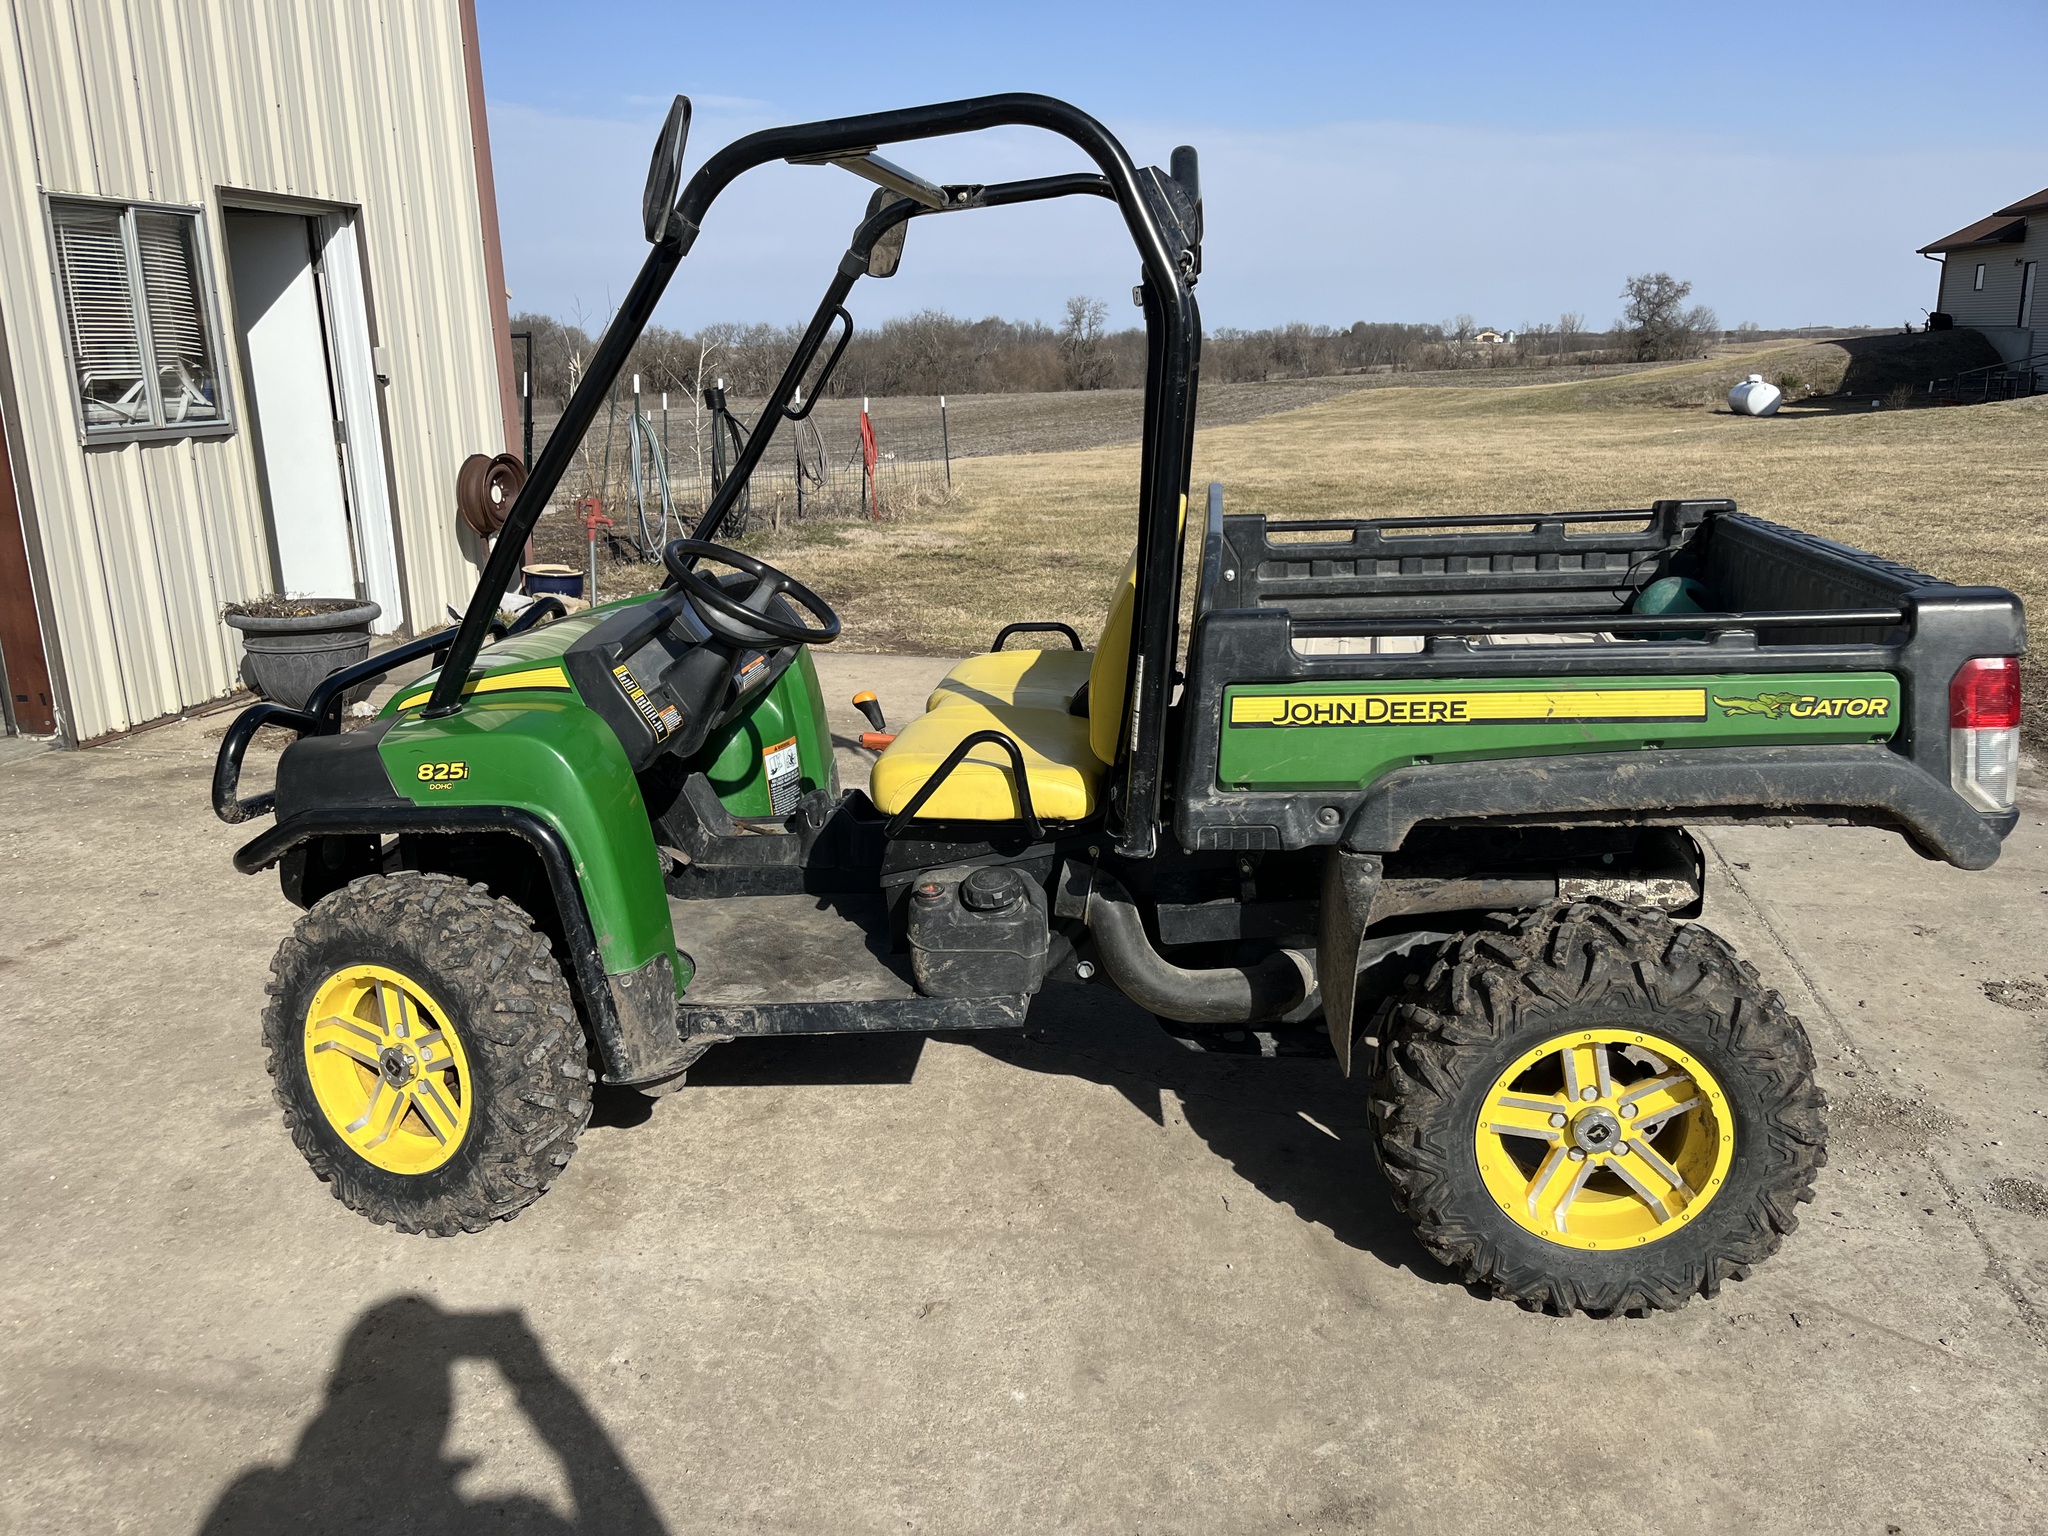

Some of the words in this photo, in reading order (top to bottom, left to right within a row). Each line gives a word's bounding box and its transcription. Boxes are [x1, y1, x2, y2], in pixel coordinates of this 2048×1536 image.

[1273, 699, 1356, 721] JOHN
[1365, 698, 1468, 720] DEERE
[1789, 696, 1889, 718] GATOR
[417, 762, 469, 781] 825i
